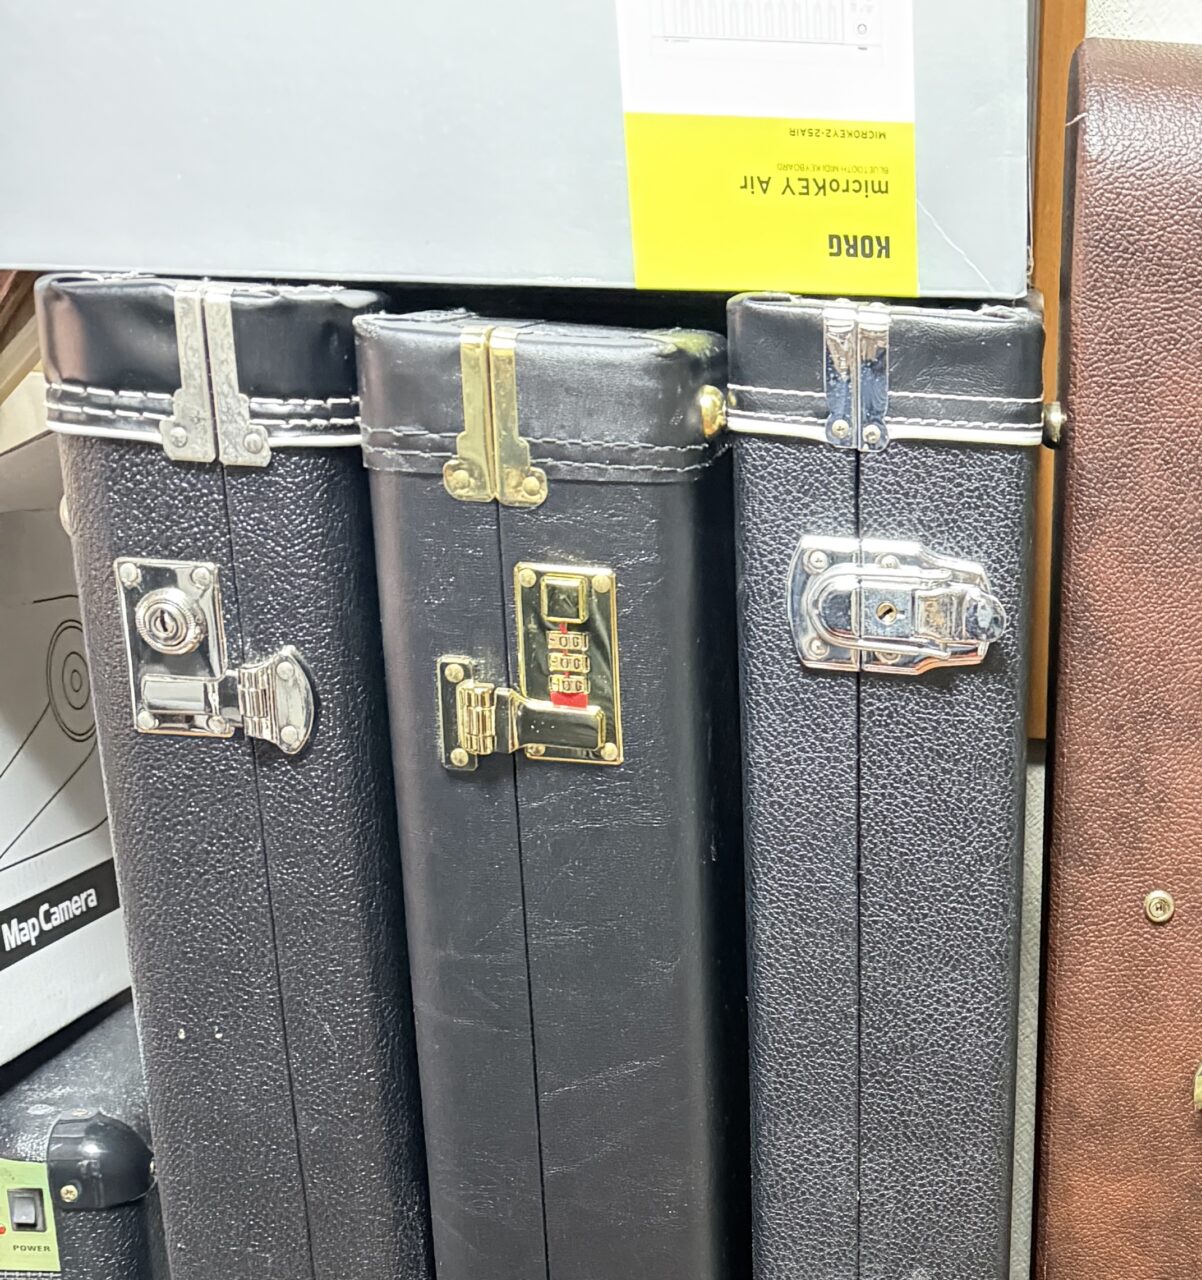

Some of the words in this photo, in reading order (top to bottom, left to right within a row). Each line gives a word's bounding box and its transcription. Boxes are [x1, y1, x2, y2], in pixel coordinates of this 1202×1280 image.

[789, 128, 887, 140] MICROKEY2-25AIR
[777, 162, 821, 173] KEYBOARD
[841, 164, 889, 175] BLUETOOTH
[740, 175, 772, 195] Air
[781, 177, 889, 198] microKEY
[828, 234, 891, 259] KORG
[1, 917, 40, 952] Map
[39, 888, 98, 932] Camera
[12, 1244, 52, 1252] POWER
